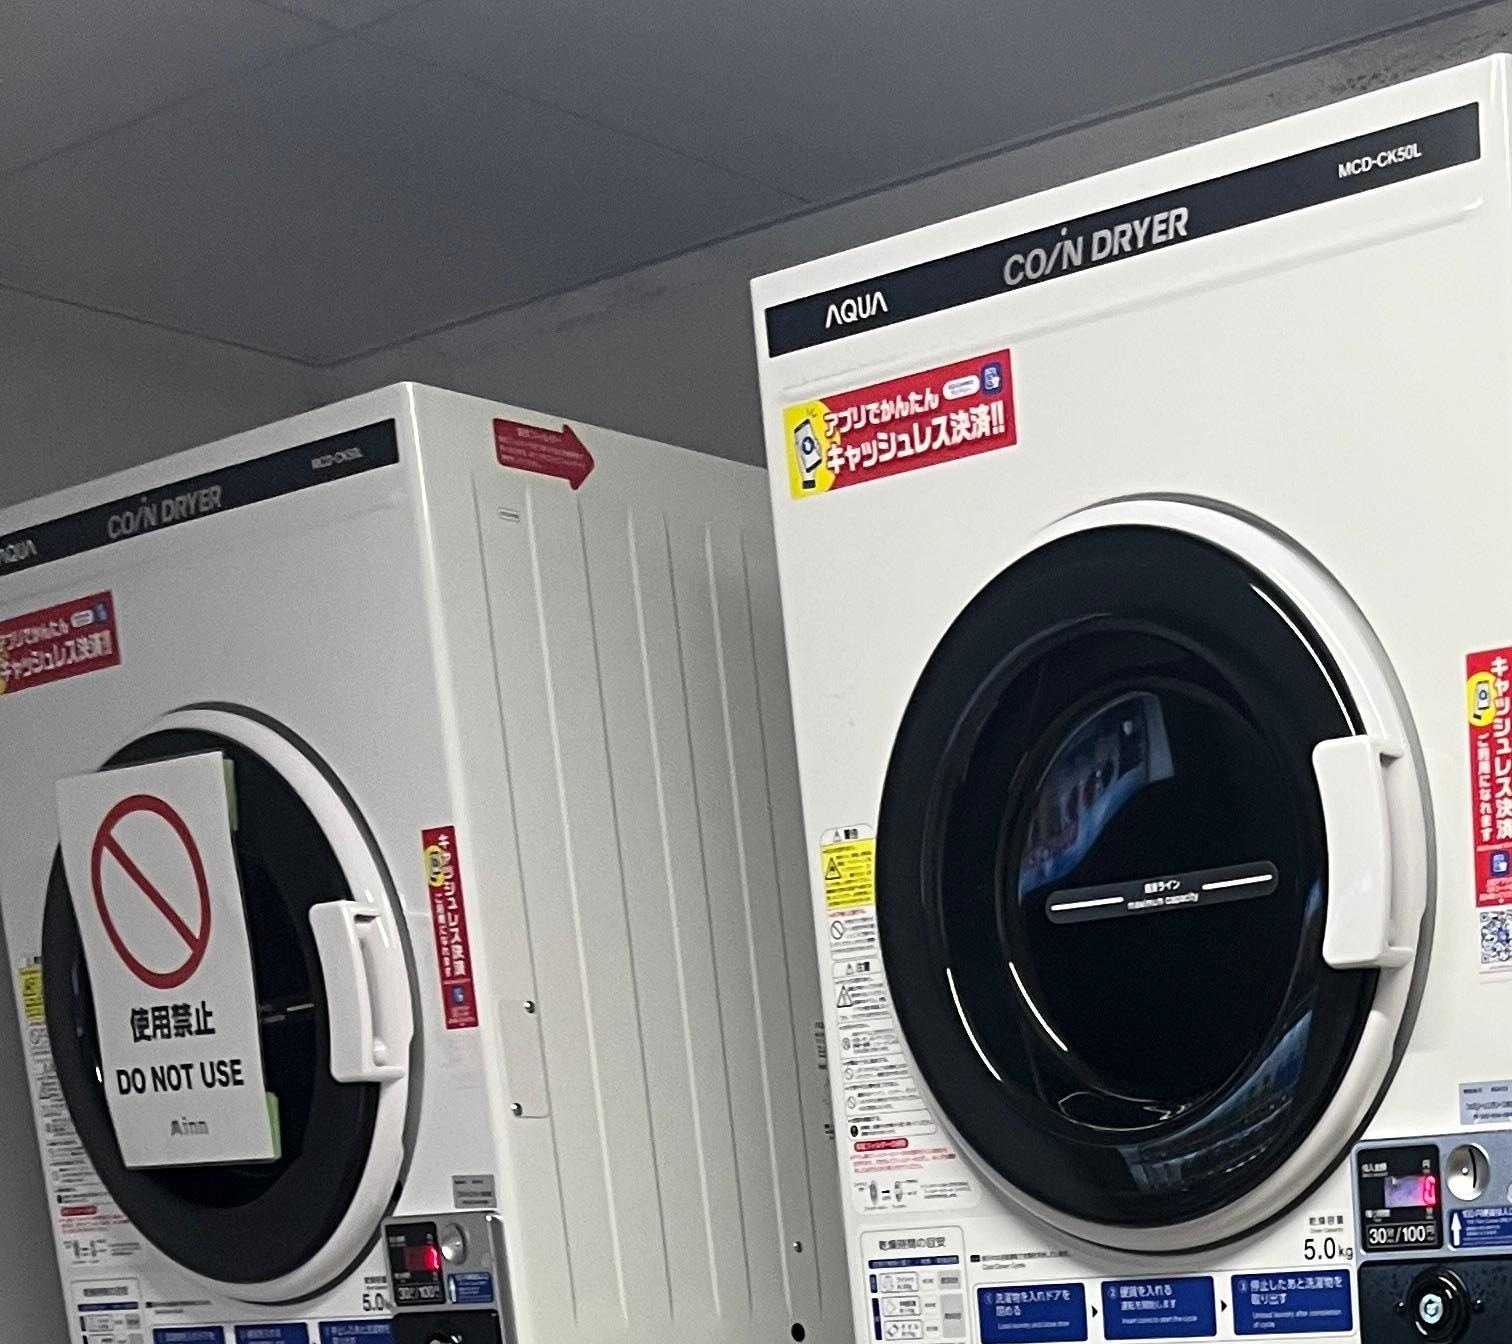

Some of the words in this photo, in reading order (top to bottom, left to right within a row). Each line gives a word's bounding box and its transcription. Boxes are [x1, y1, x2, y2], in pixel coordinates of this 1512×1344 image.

[1338, 143, 1422, 179] MCD-CK50L
[1091, 206, 1190, 260] DRYER
[825, 292, 888, 328] AQUA
[824, 388, 939, 437] アプリでかんたん
[827, 400, 1006, 474] キャッシュレス決済!!
[161, 485, 222, 523] DRYER
[130, 1000, 216, 1043] 使用禁止
[116, 1068, 146, 1095] DO
[151, 1063, 194, 1092] NOT
[200, 1059, 245, 1088] USE
